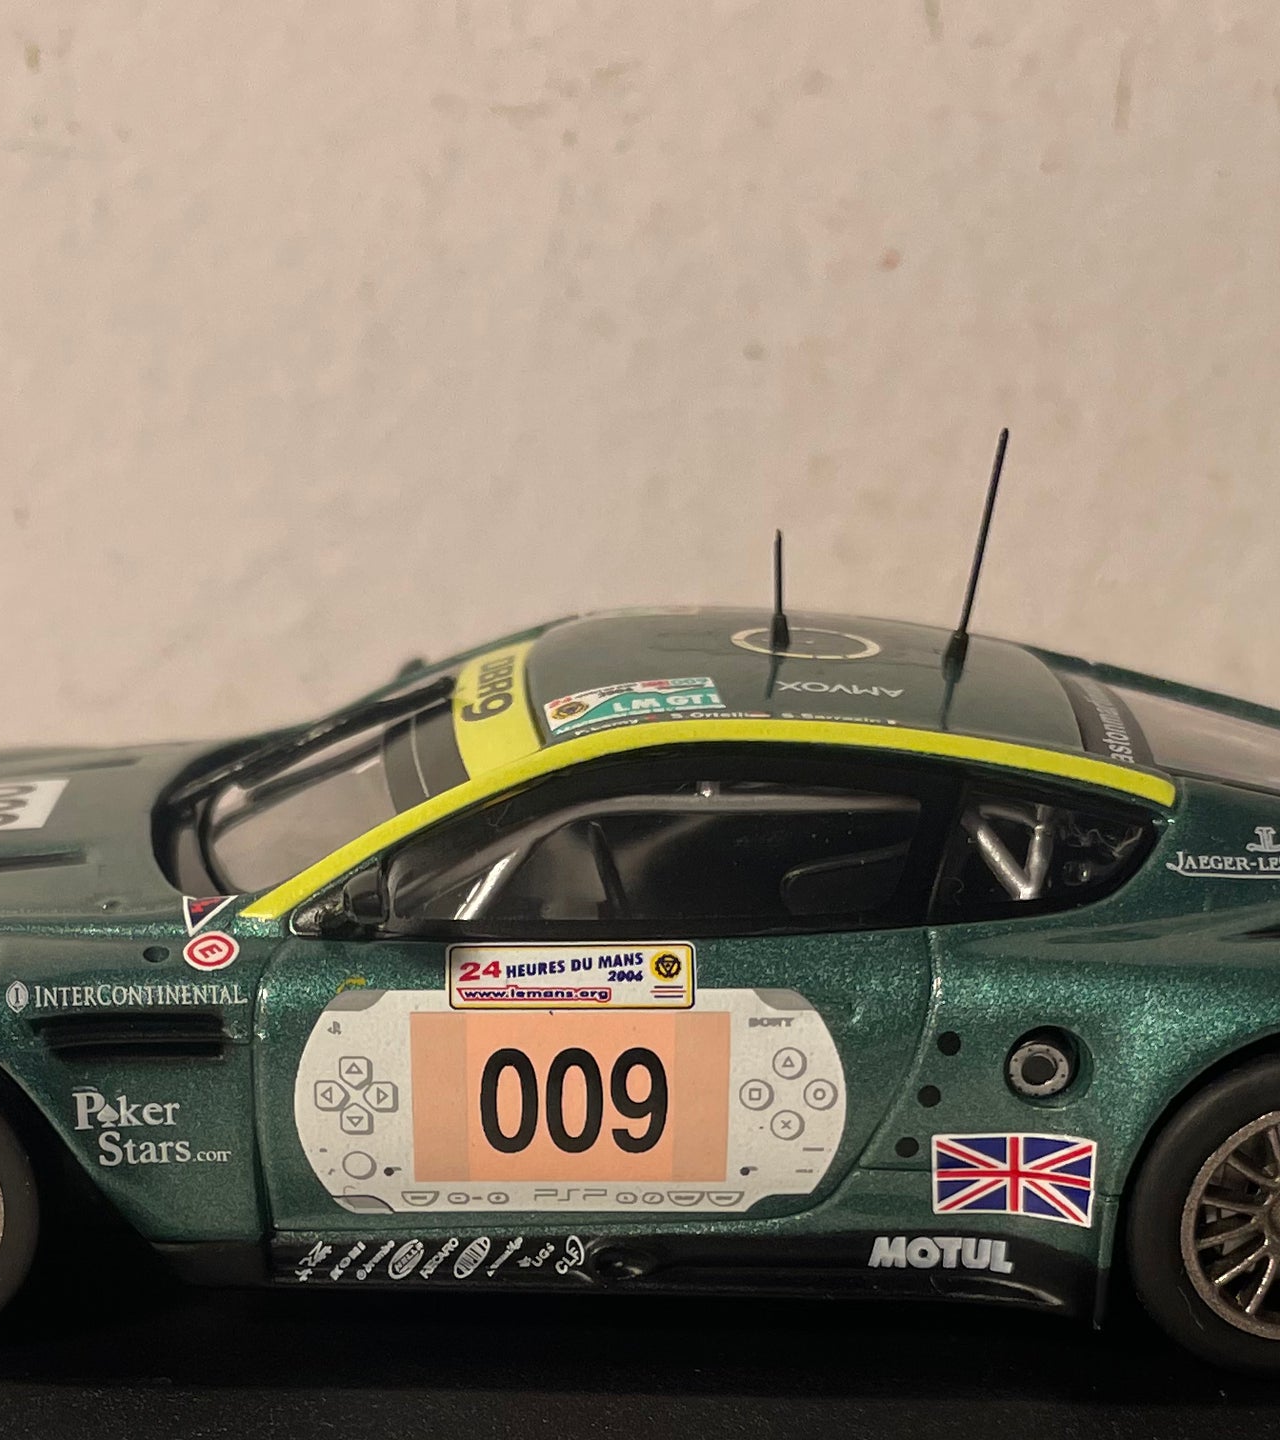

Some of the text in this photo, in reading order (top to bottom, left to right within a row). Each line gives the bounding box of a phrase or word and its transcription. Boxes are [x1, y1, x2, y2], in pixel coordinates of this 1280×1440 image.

[775, 680, 905, 698] AMVOX
[459, 952, 644, 982] 24 HEURES DU MANS
[608, 970, 644, 982] 2006
[34, 984, 248, 1009] INTERCONTINENTAL
[464, 988, 609, 1001] www.lemans.org
[480, 1047, 669, 1154] 009
[868, 1236, 1014, 1274] MOTUL
